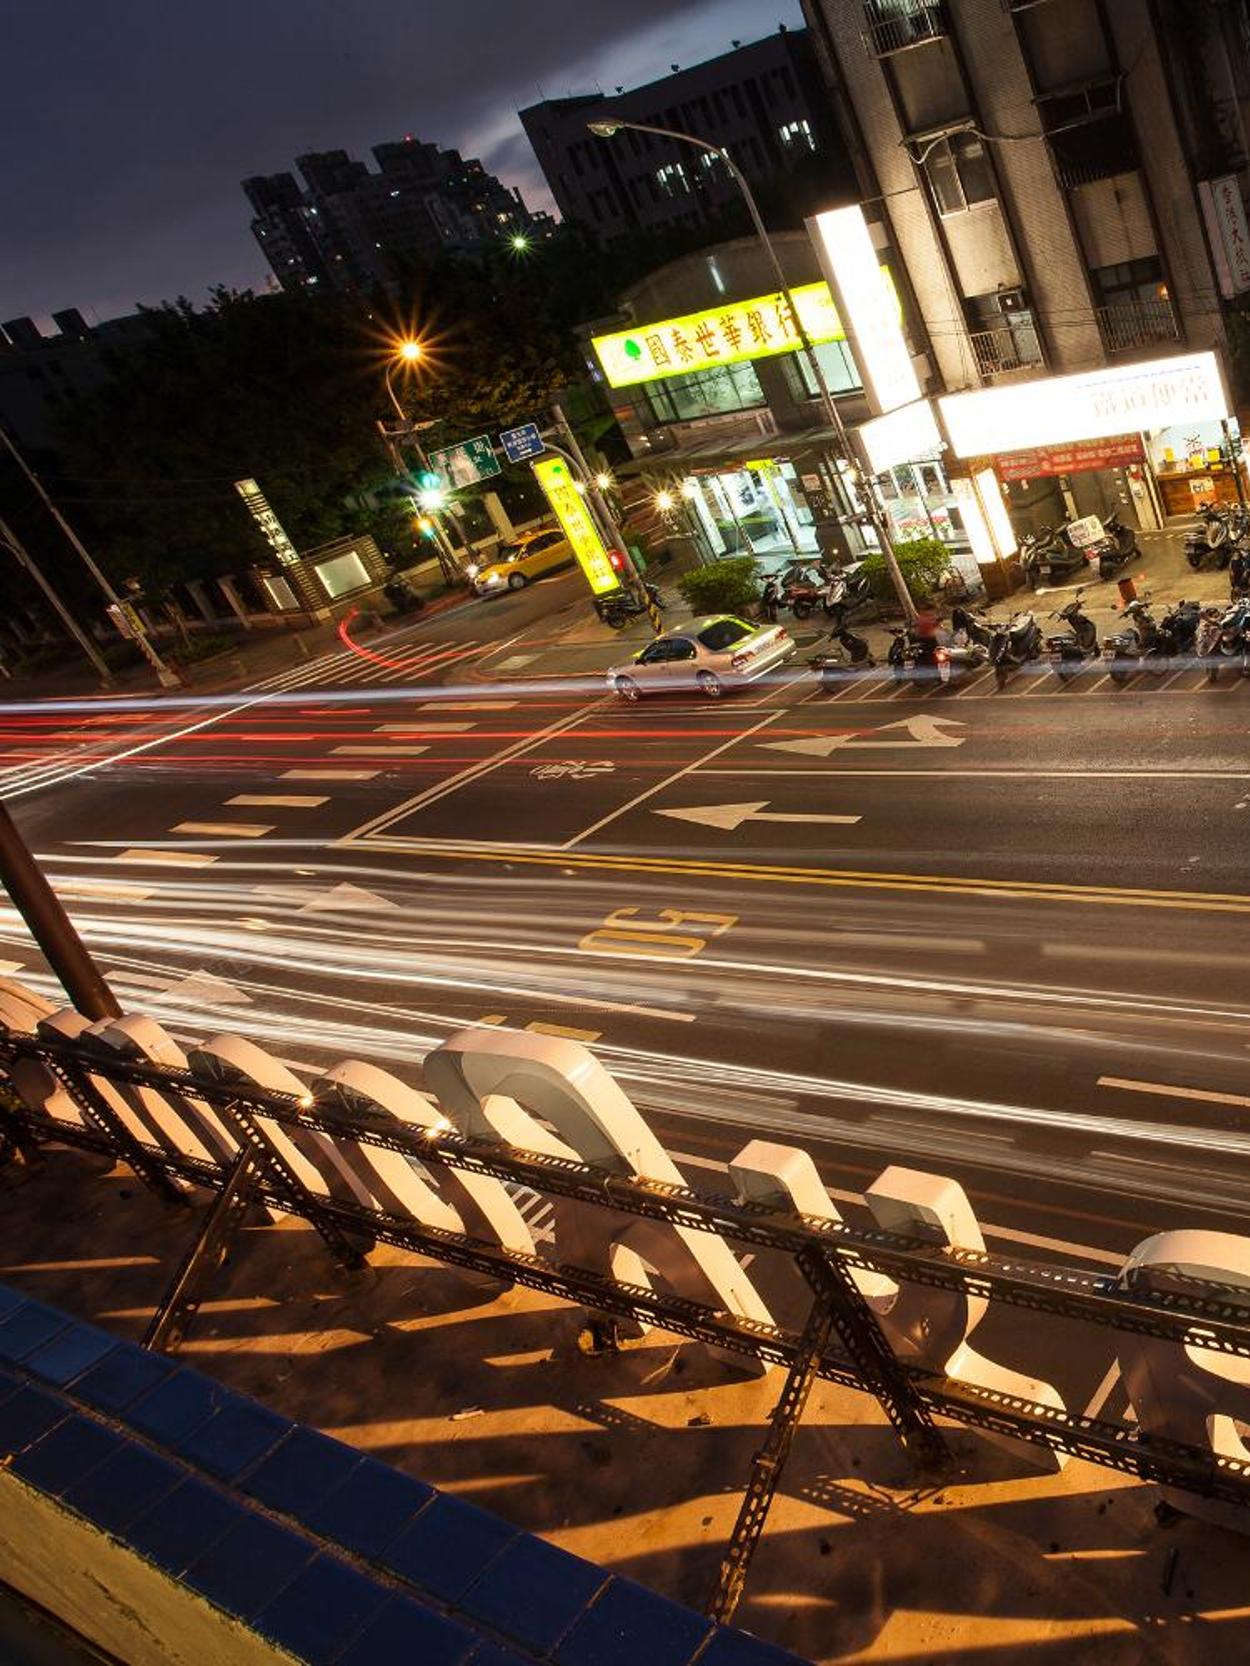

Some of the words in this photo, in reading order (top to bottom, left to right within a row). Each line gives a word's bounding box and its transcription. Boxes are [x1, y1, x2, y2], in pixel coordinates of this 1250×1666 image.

[645, 302, 800, 367] 國泰世華銀行
